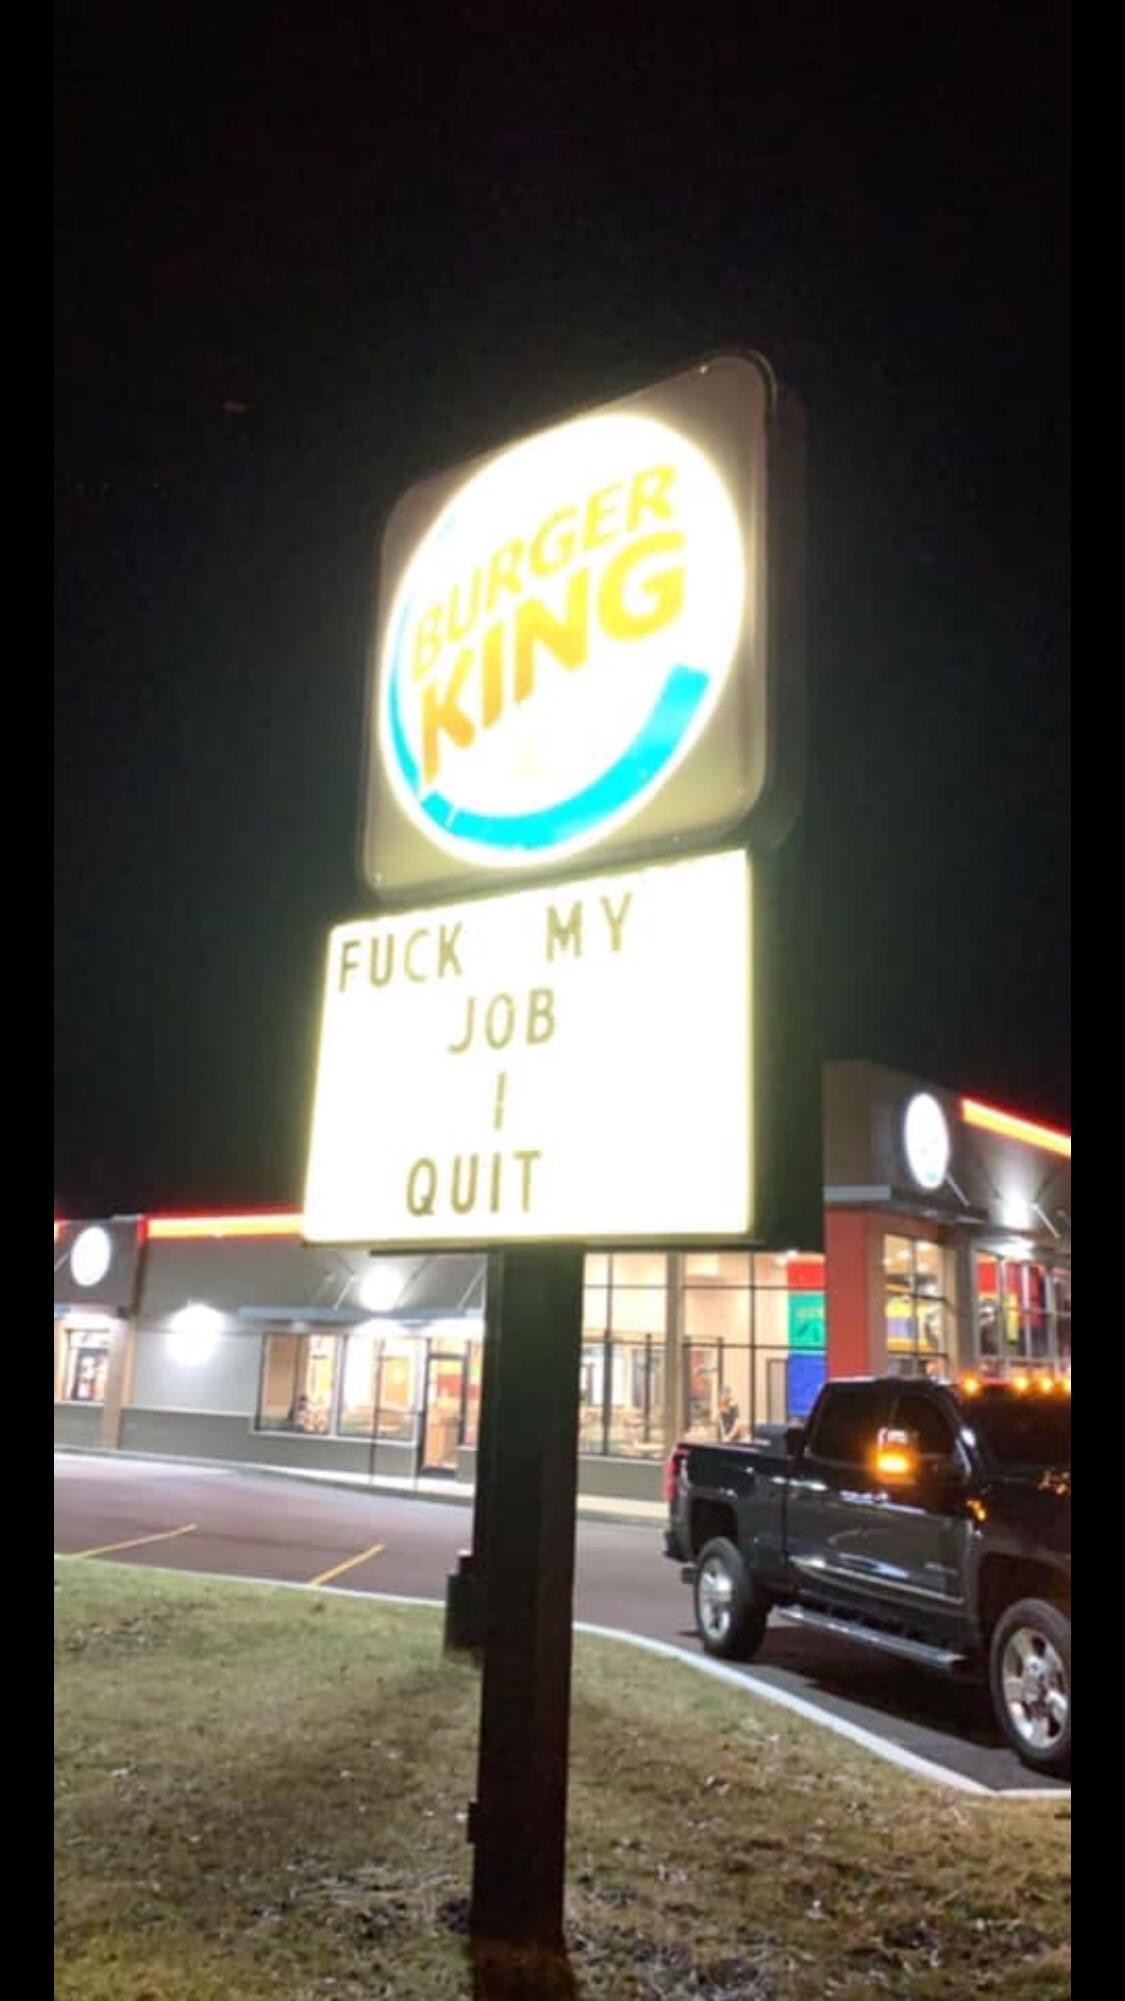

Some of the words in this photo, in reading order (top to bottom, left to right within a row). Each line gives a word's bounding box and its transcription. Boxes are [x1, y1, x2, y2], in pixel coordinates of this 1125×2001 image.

[412, 465, 678, 683] BURGER
[421, 531, 685, 785] KING
[339, 922, 462, 992] FUCK
[545, 892, 632, 962] MY
[448, 987, 556, 1054] JOB
[494, 1072, 506, 1130] I
[406, 1150, 540, 1216] QUIT
